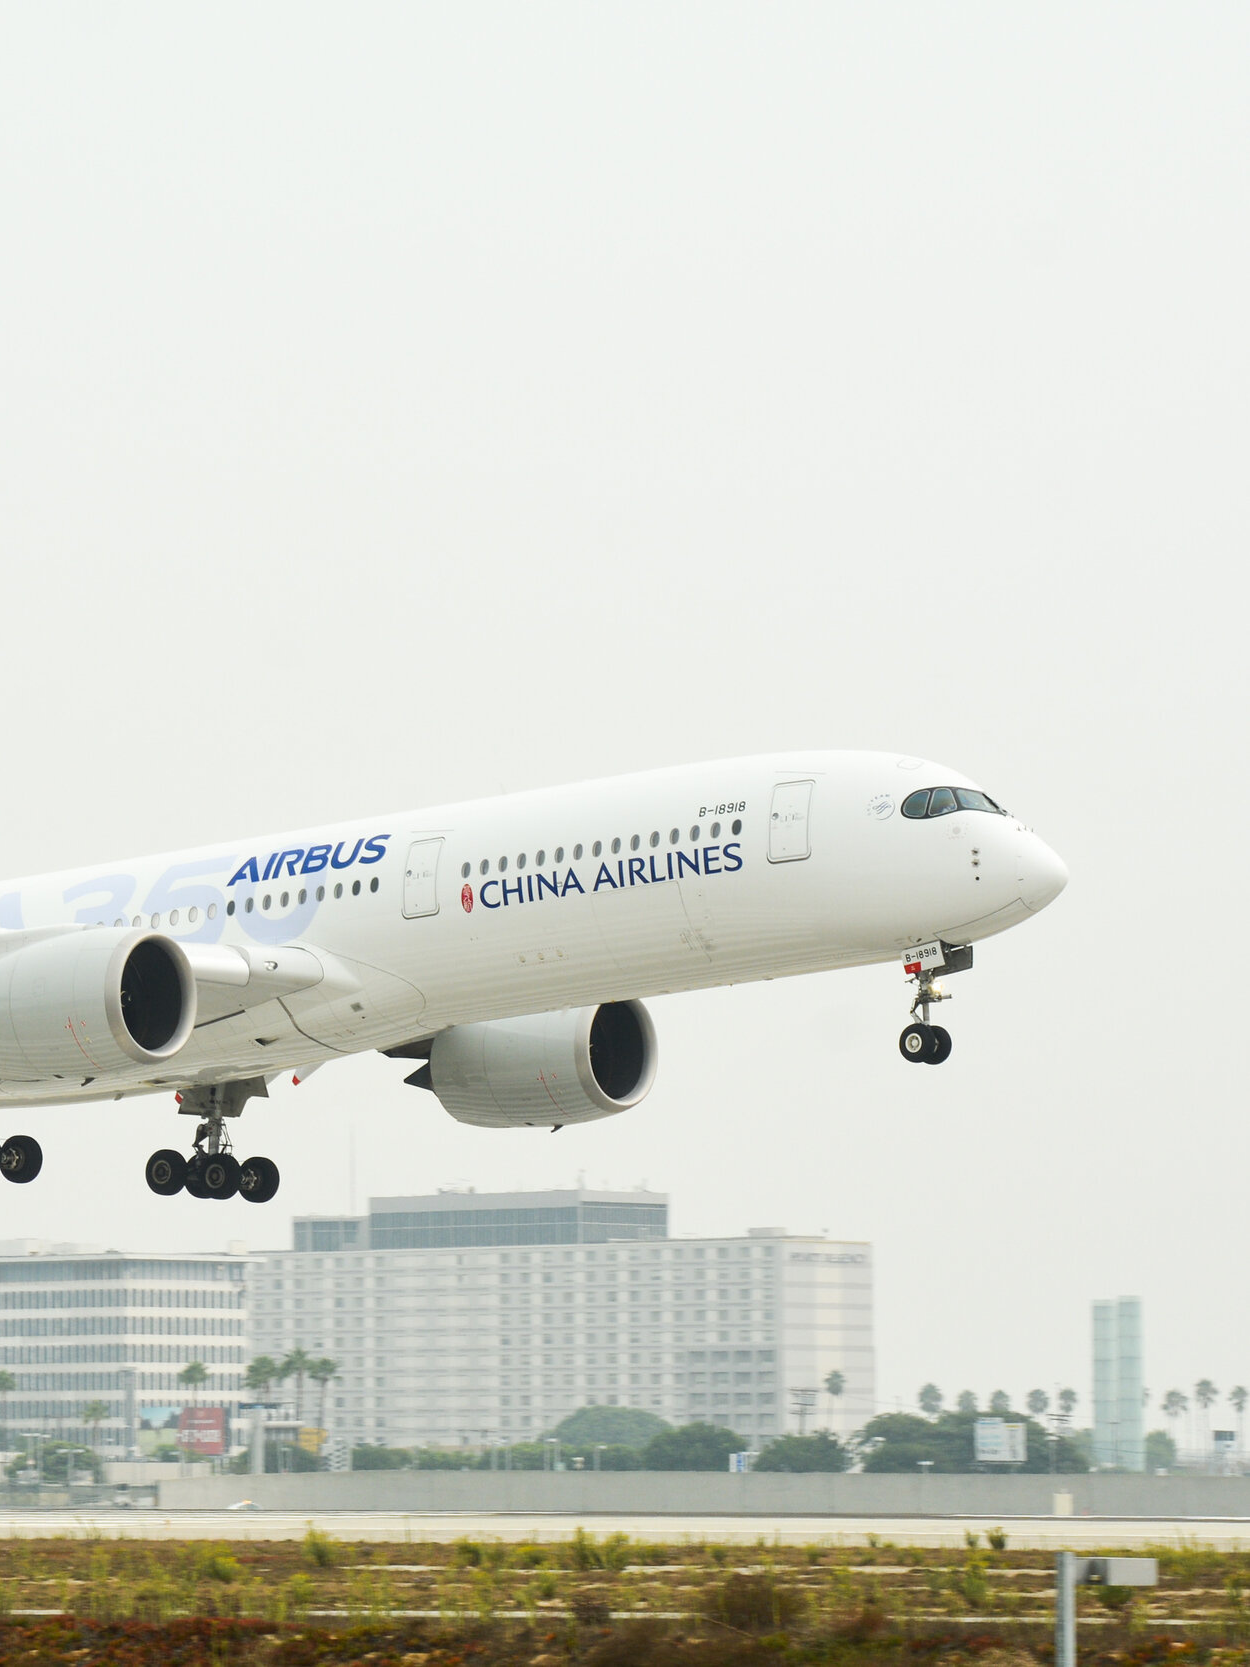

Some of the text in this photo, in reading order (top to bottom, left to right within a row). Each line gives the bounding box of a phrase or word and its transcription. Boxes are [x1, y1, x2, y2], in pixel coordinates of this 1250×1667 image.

[699, 801, 746, 817] B-18918
[226, 834, 392, 887] AIRBUS
[479, 867, 585, 909] CHINA
[593, 843, 743, 891] AIRLINES
[905, 946, 937, 962] B-18918
